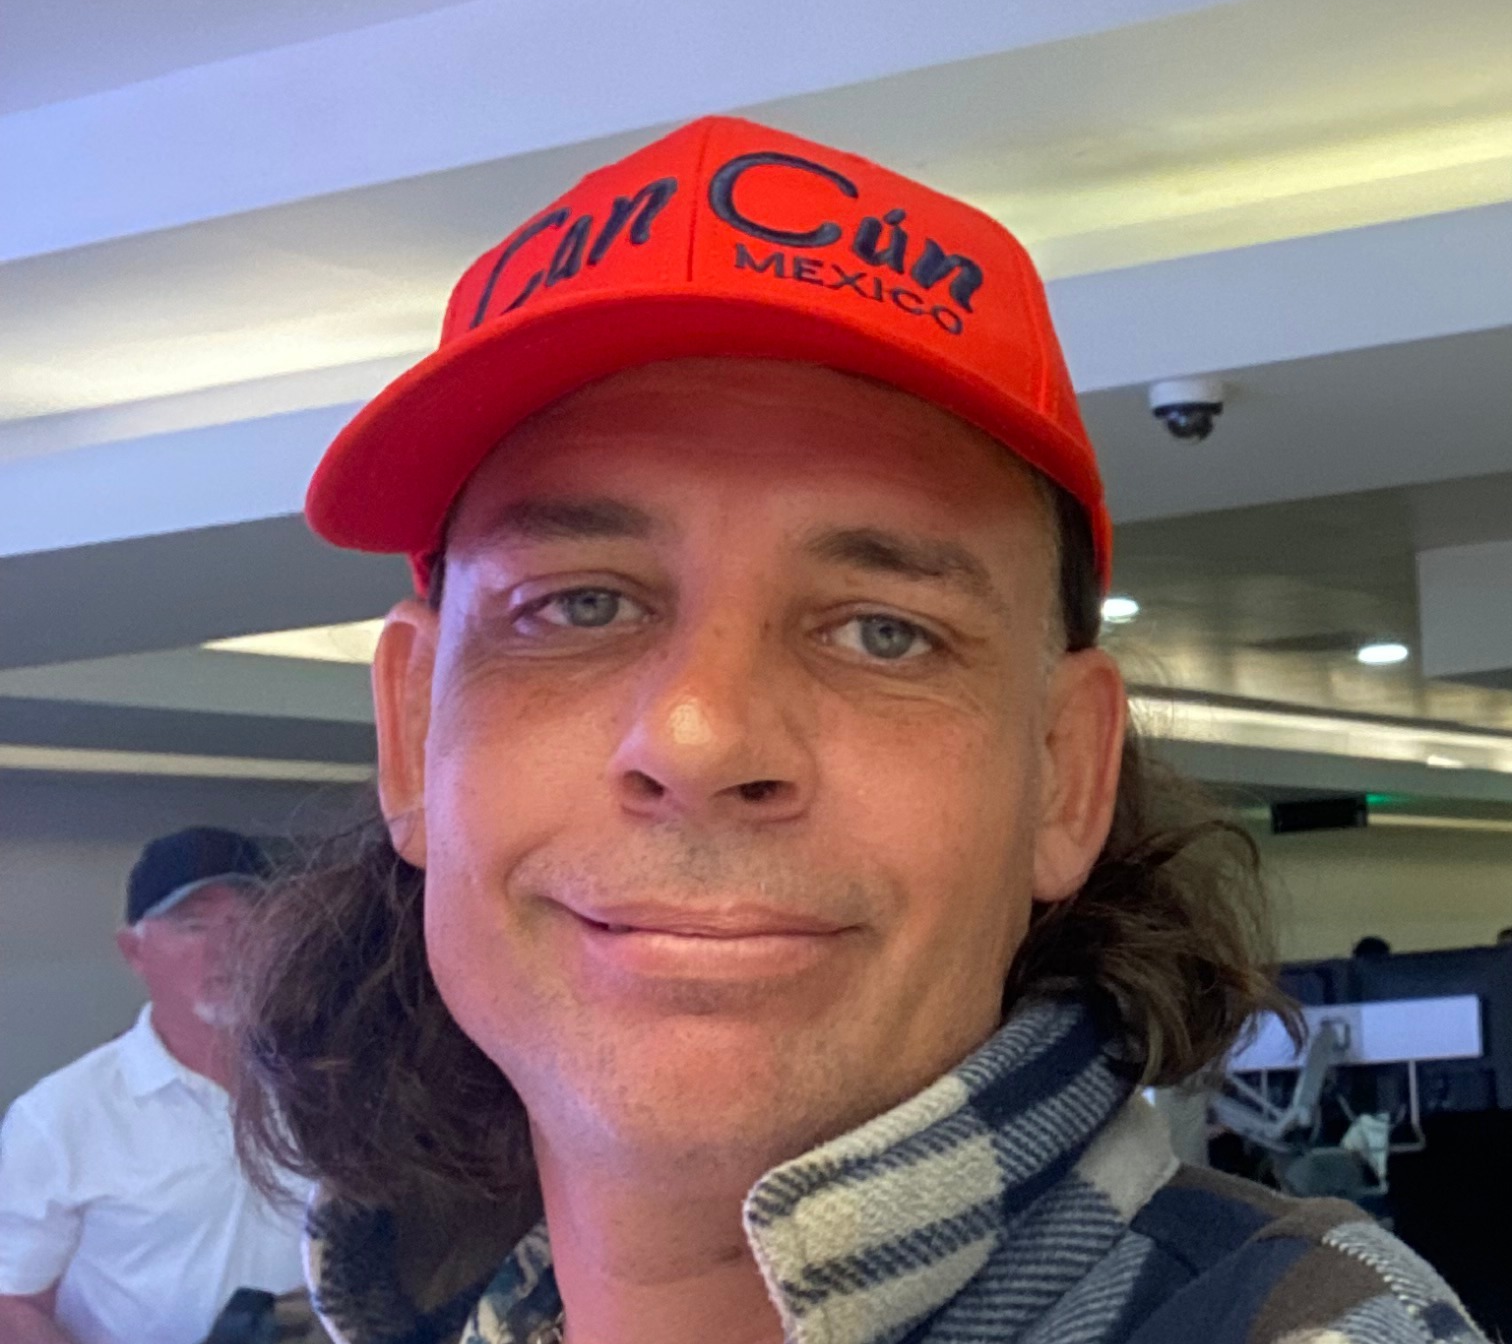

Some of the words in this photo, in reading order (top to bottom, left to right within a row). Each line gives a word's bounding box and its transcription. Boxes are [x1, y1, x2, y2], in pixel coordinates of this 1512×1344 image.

[469, 176, 678, 330] Can
[708, 151, 983, 314] Cún
[734, 243, 962, 335] MEXICO
